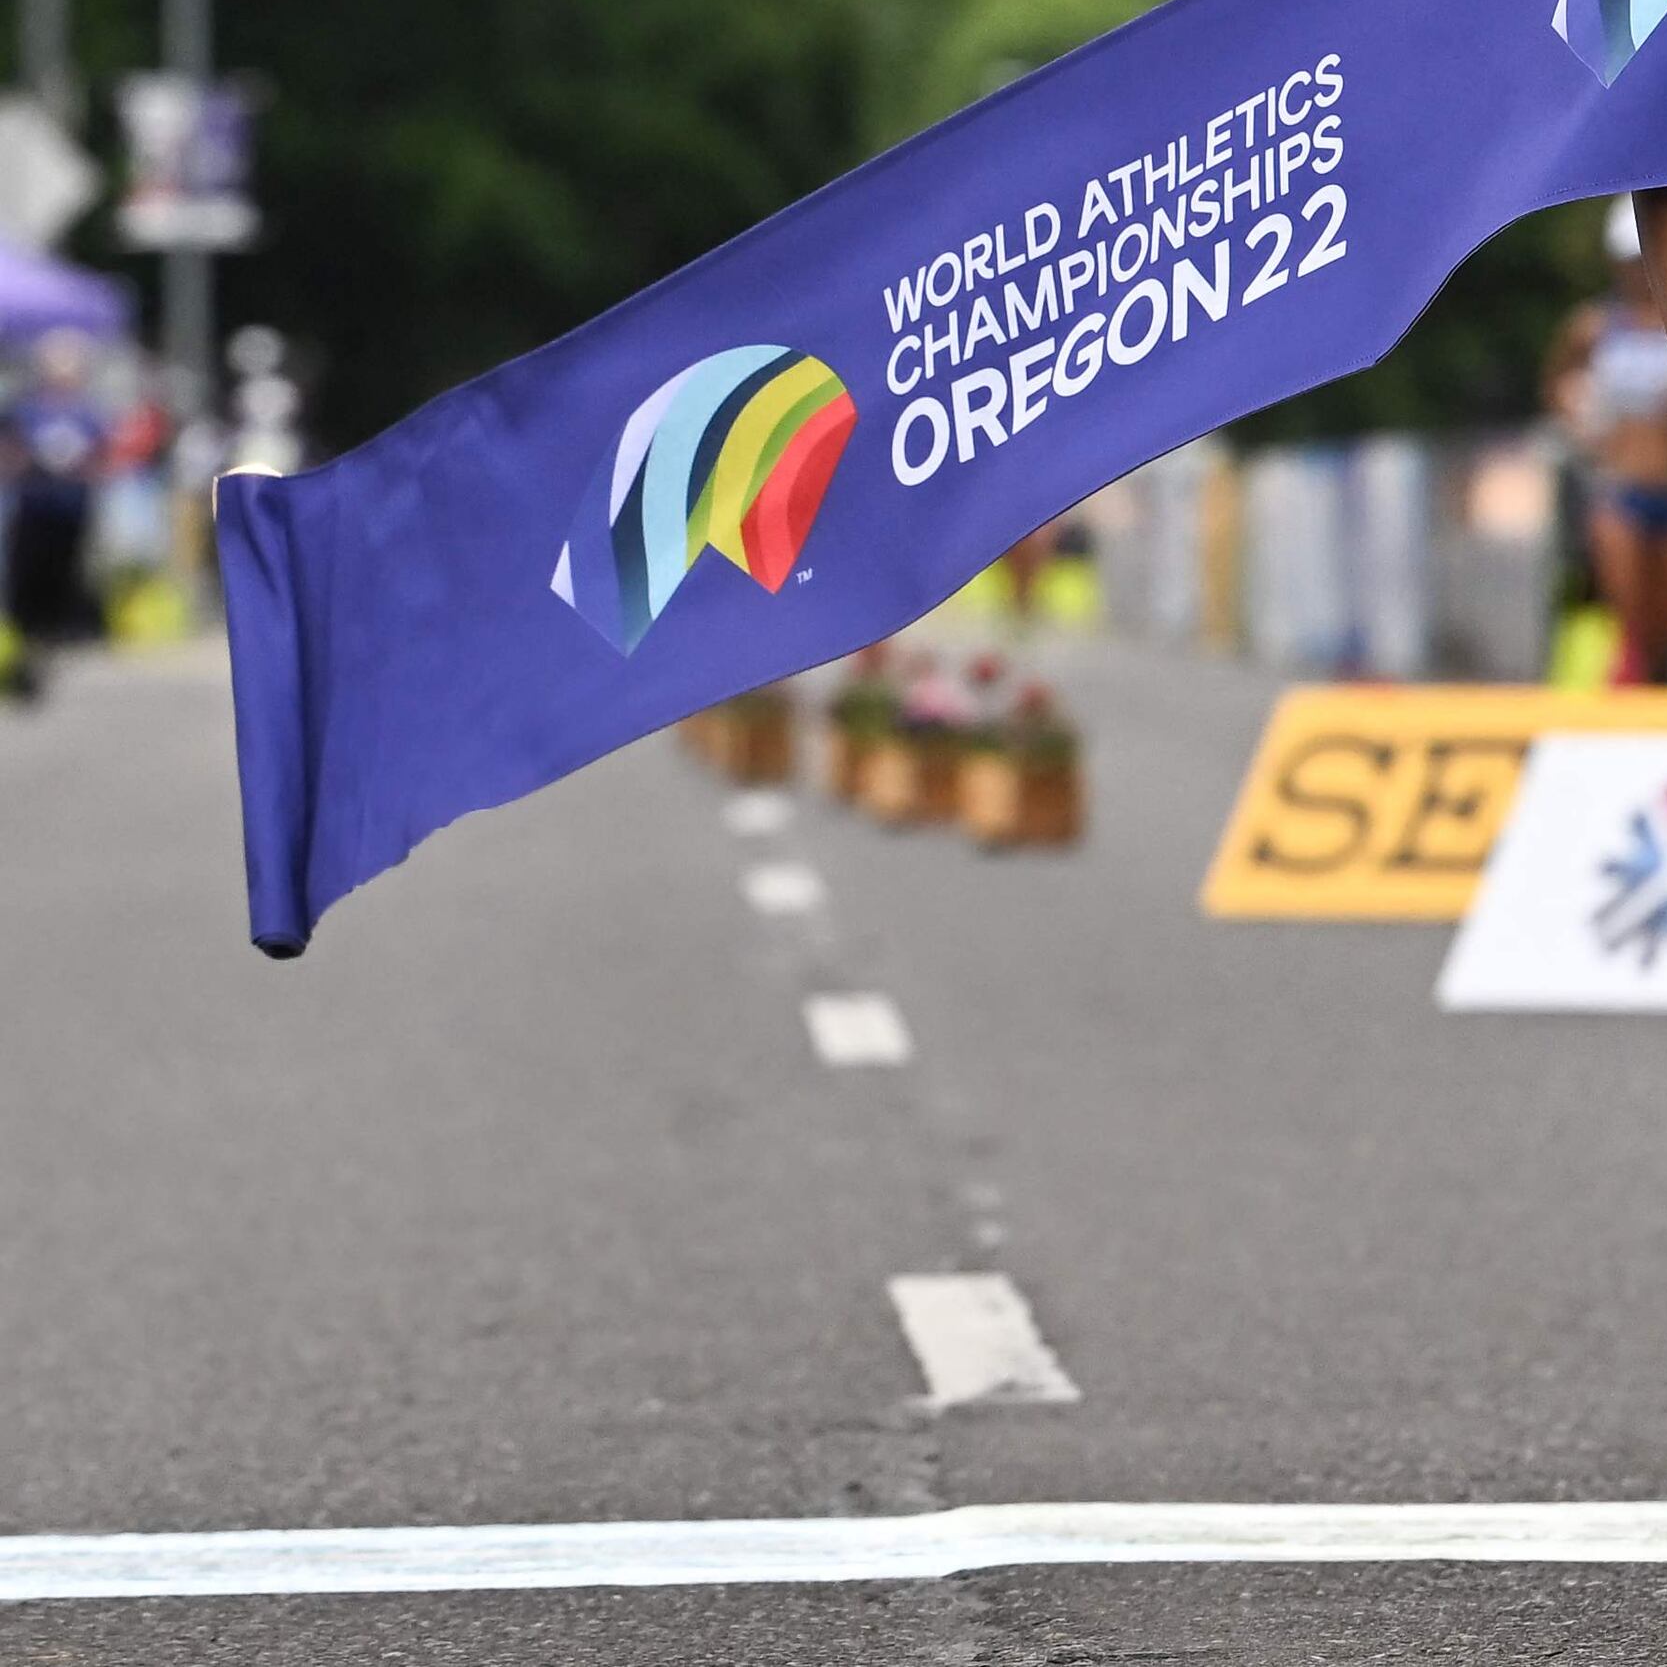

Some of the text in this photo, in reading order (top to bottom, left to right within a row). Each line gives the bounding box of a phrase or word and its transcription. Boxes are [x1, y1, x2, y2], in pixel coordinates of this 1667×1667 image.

[883, 53, 1344, 334] WORLD ATHLETICS
[887, 115, 1344, 395] CHAMPIONSHIPS
